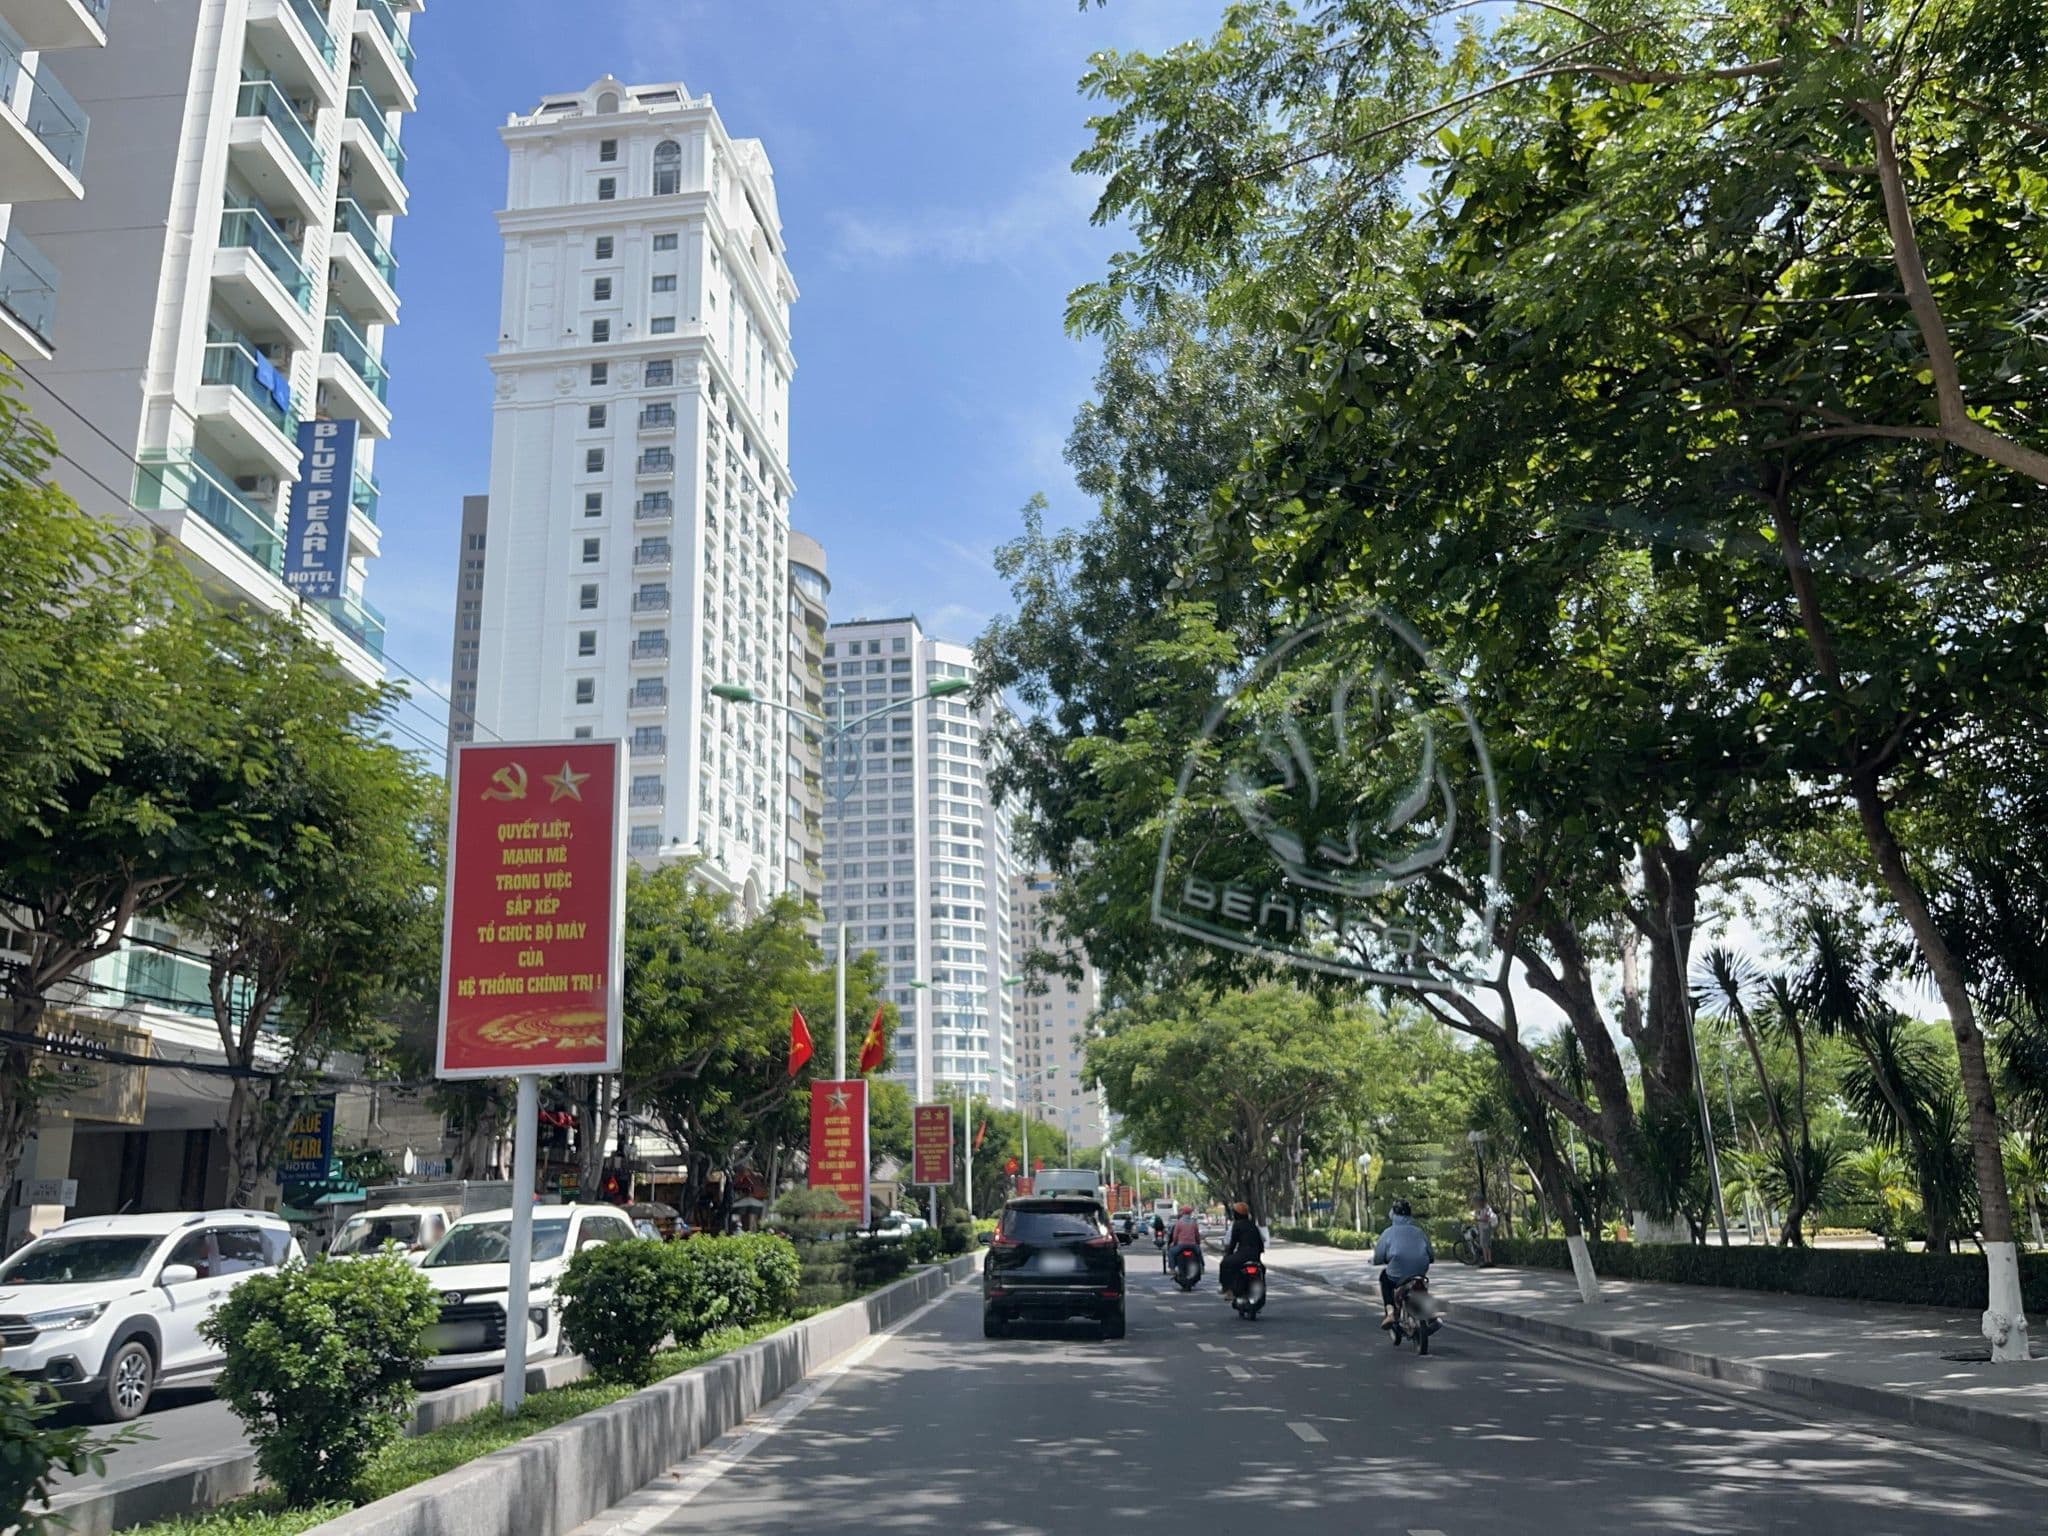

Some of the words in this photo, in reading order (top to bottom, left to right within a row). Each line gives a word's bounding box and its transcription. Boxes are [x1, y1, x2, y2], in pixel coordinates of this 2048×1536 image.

[311, 423, 338, 484] BLUE
[302, 490, 332, 568] PEARL
[288, 571, 336, 583] HOTEL
[498, 818, 540, 843] QUYẾT
[542, 819, 573, 840] LIỆT,
[503, 848, 543, 867] MẠNH
[496, 873, 540, 890] TRONG
[544, 869, 572, 891] VIỆC
[506, 893, 531, 916] SẮP
[535, 893, 560, 915] XẾP
[478, 920, 495, 943] TỔ
[498, 922, 532, 942] CHỨC
[535, 921, 553, 943] BỘ
[557, 920, 586, 940] MÁY
[518, 946, 544, 967] CỦA
[458, 976, 476, 999] HỆ
[479, 972, 523, 995] THỐNG
[528, 972, 568, 993] CHÍNH
[572, 974, 593, 992] TRỊ
